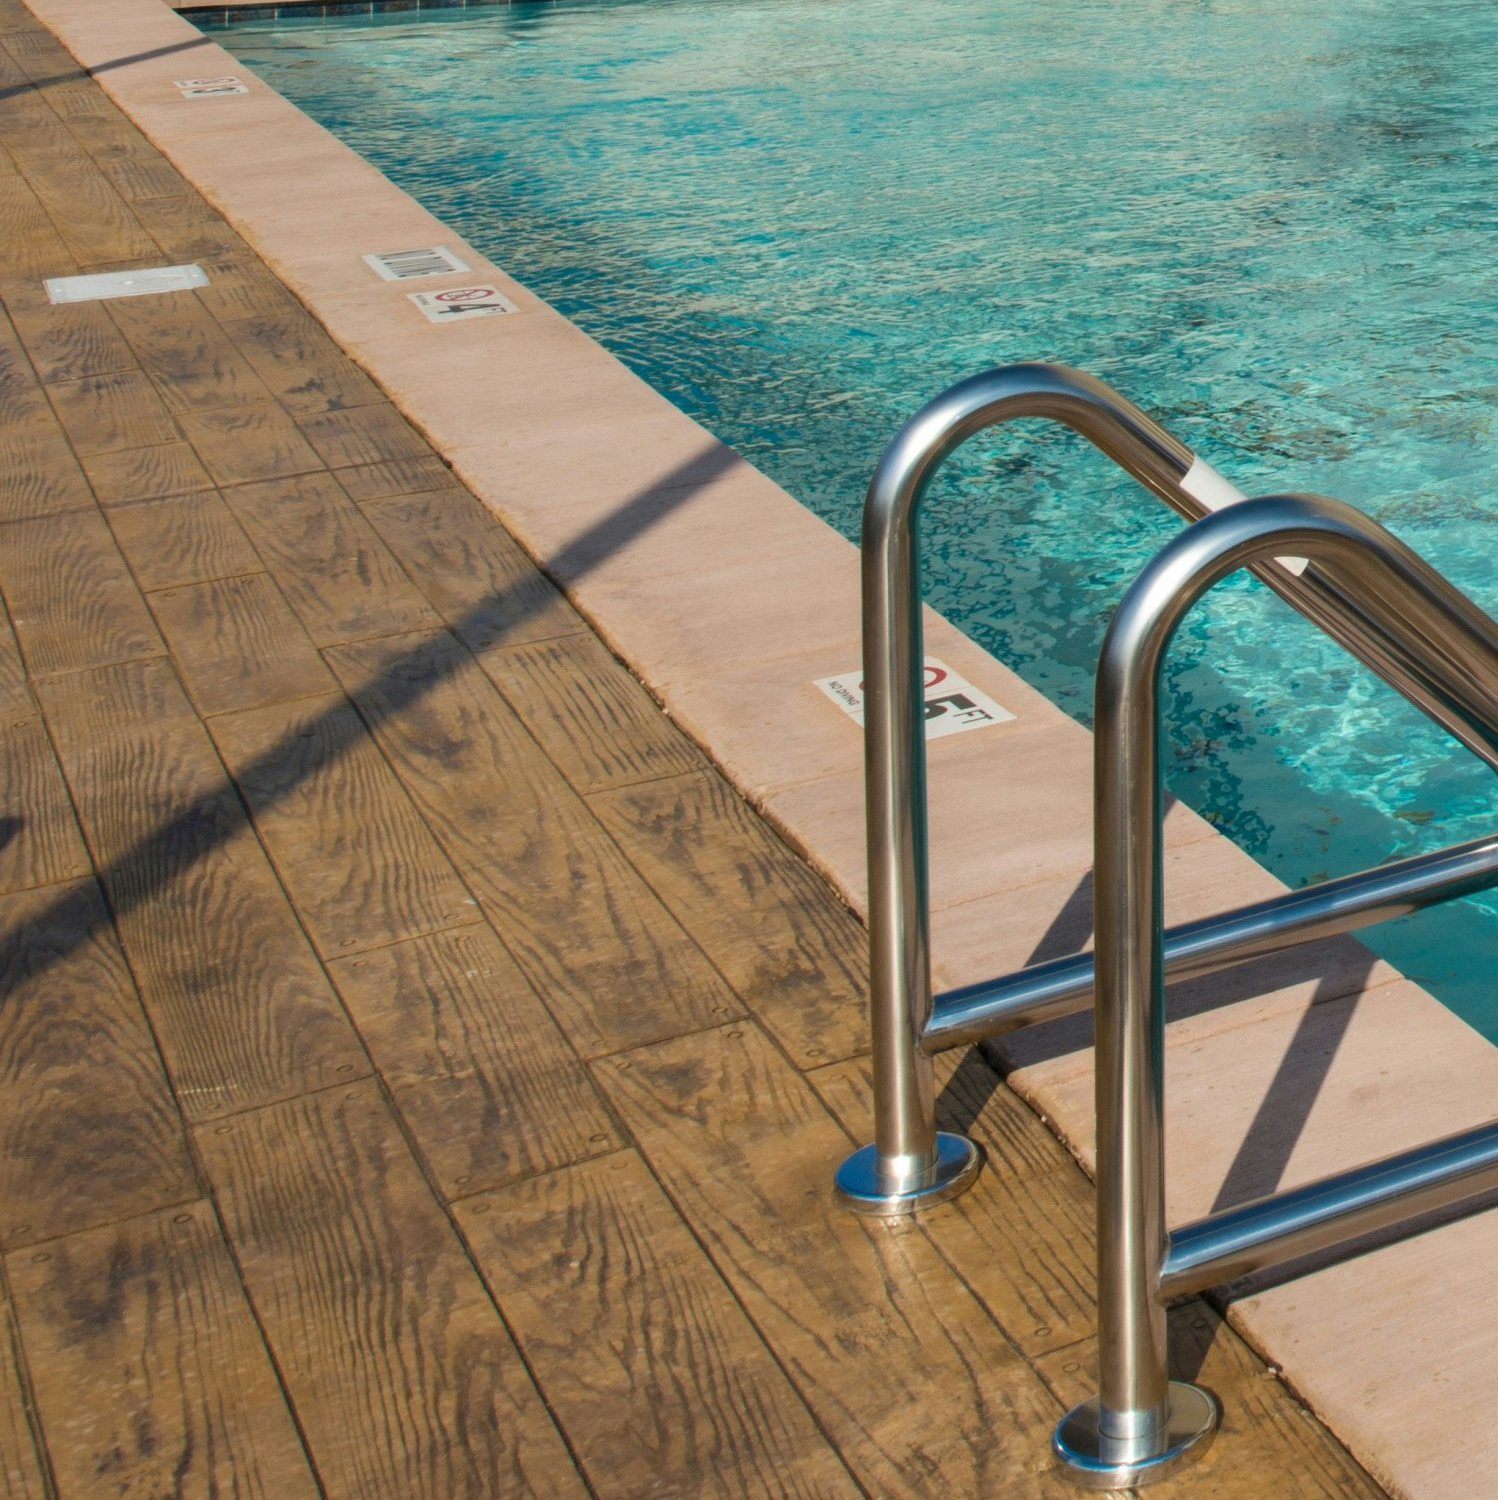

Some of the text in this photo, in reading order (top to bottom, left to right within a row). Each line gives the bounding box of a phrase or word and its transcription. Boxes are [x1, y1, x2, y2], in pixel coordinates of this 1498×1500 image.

[829, 681, 859, 705] NO DIVING
[953, 709, 994, 724] FT
